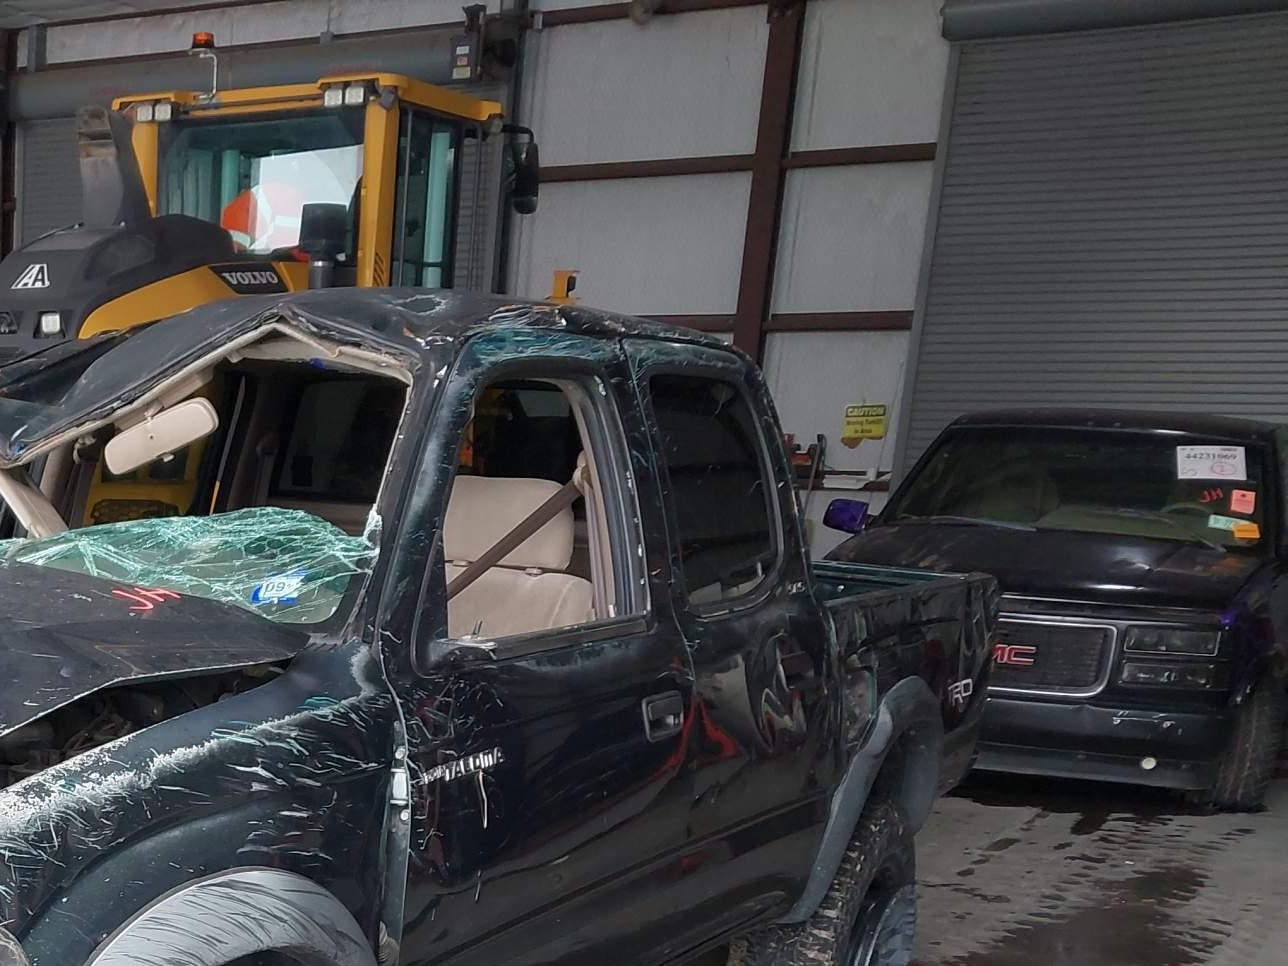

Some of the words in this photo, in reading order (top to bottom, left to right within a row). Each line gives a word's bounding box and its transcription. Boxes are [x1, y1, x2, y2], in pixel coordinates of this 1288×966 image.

[221, 270, 280, 286] VOLVO
[847, 406, 885, 417] CAUTION
[947, 678, 973, 706] TRD
